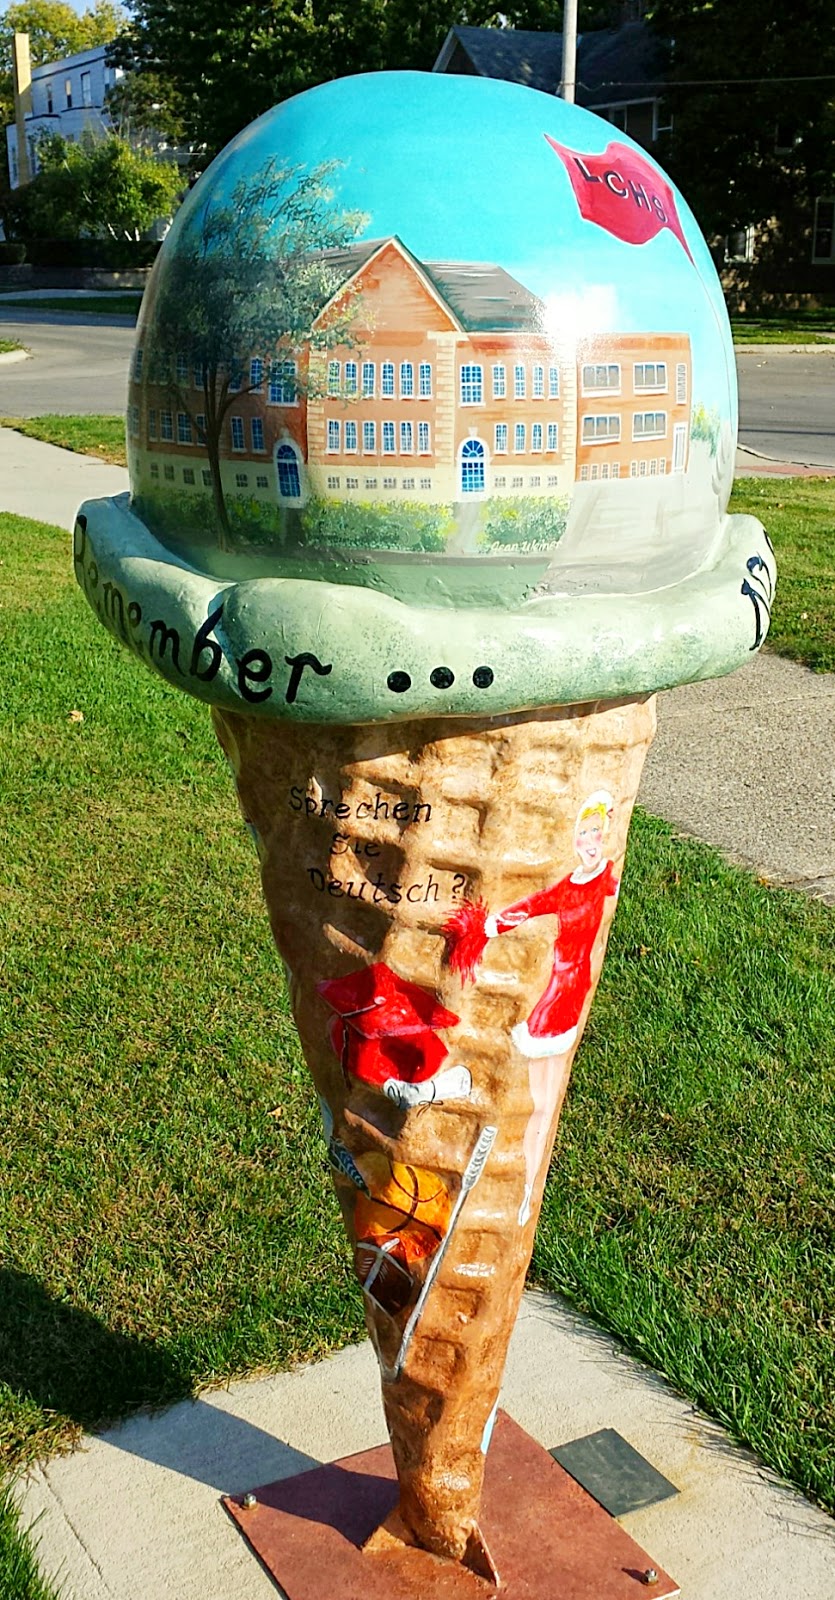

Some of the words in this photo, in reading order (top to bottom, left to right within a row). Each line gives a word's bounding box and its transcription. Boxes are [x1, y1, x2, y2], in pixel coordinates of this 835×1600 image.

[573, 157, 669, 223] LCHS
[288, 786, 433, 823] Sprechen
[330, 832, 381, 858] Sie
